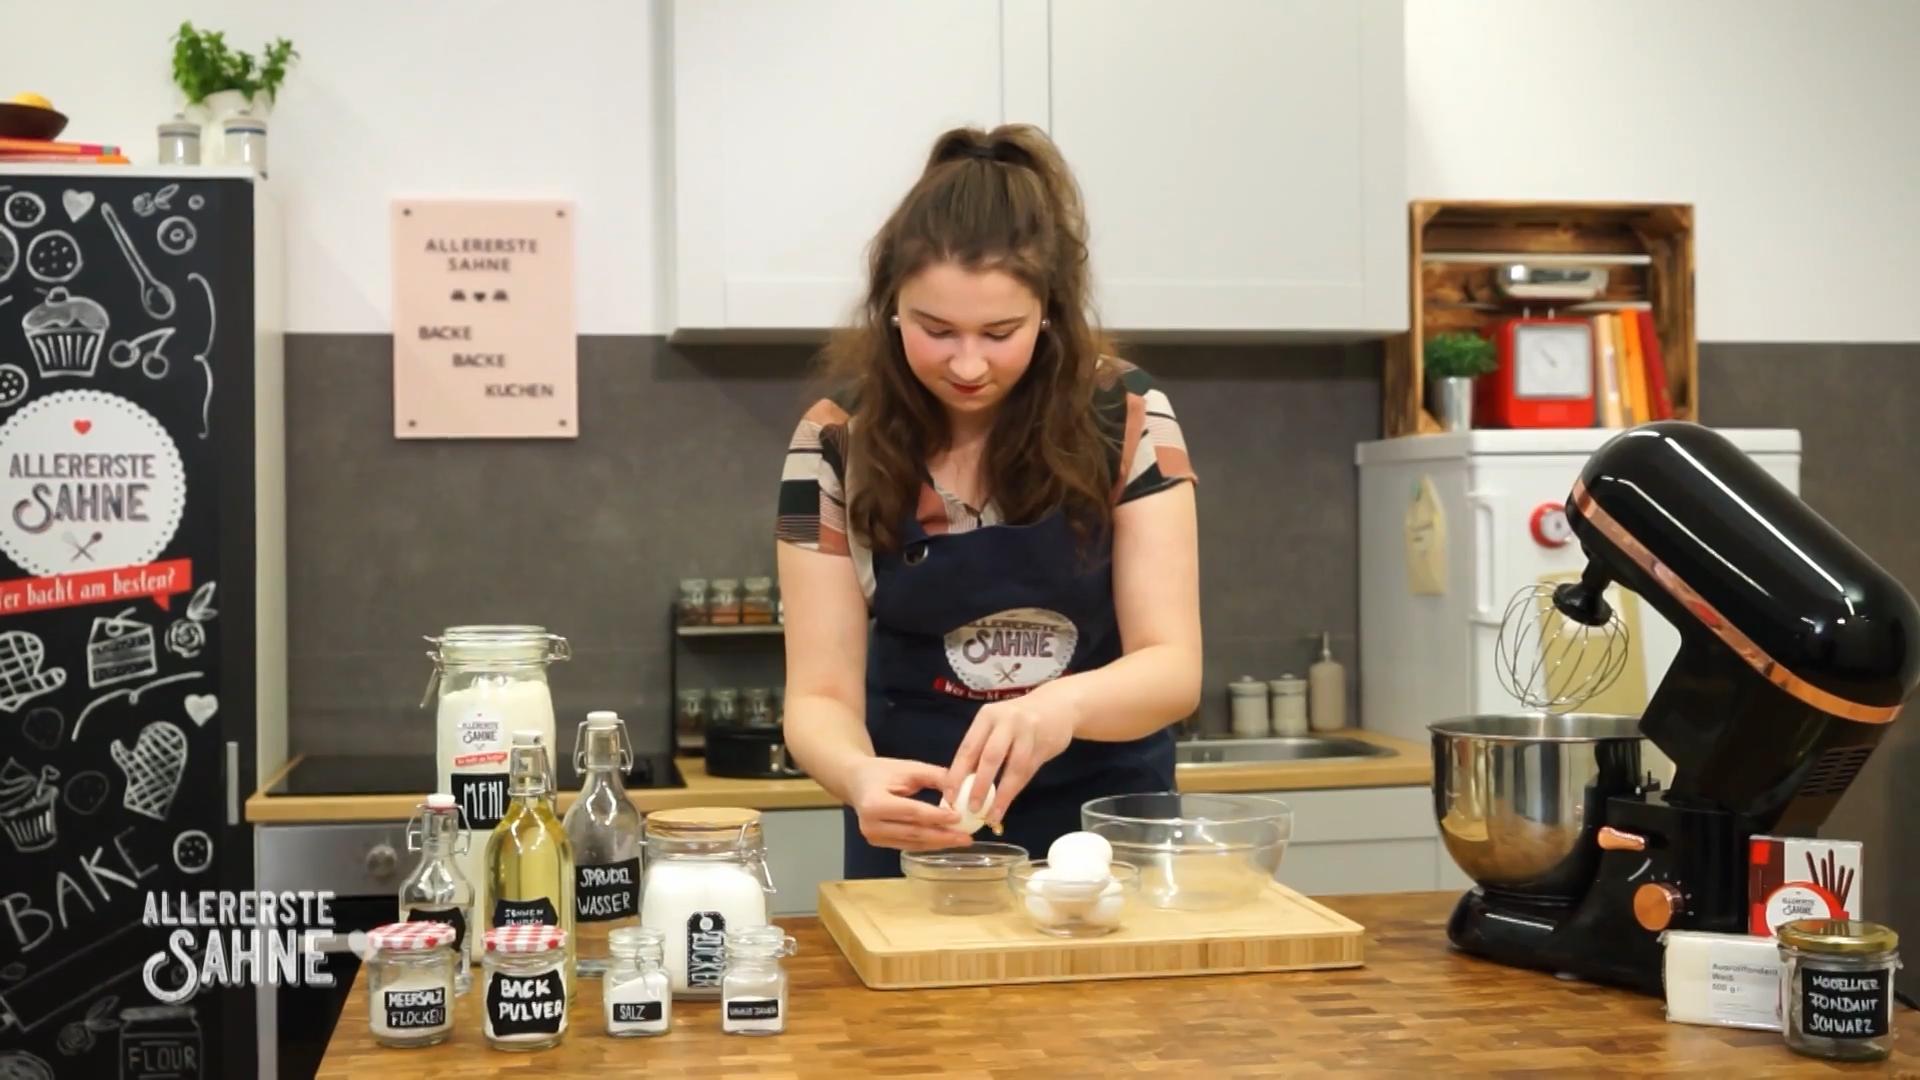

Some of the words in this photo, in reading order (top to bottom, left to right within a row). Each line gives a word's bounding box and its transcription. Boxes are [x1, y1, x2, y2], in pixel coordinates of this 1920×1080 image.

[425, 238, 538, 253] ALLERERSTE
[448, 256, 511, 272] SAHNE
[418, 326, 472, 341] BACKE
[452, 354, 506, 368] BACKE
[485, 384, 554, 398] KUCHEN
[9, 453, 156, 479] ALLERERSTE
[12, 483, 150, 534] SAHNE
[0, 586, 20, 610] er
[27, 577, 73, 606] bacht
[80, 581, 106, 600] am
[112, 567, 175, 597] besten?
[962, 628, 1055, 665] SAHNE
[463, 780, 505, 820] MEHL
[0, 826, 159, 952] BAKE
[577, 891, 631, 916] WASSER
[501, 978, 551, 998] BACK
[1812, 975, 1881, 992] MODELLIER
[389, 990, 443, 1008] MEERSALZ
[1808, 992, 1879, 1012] FONDANT
[390, 1009, 443, 1026] FLOCKEN
[498, 999, 563, 1021] PULVER
[619, 1004, 647, 1020] SALZ
[1809, 1012, 1875, 1034] SCHWARZ
[127, 1046, 198, 1072] FLOUR
